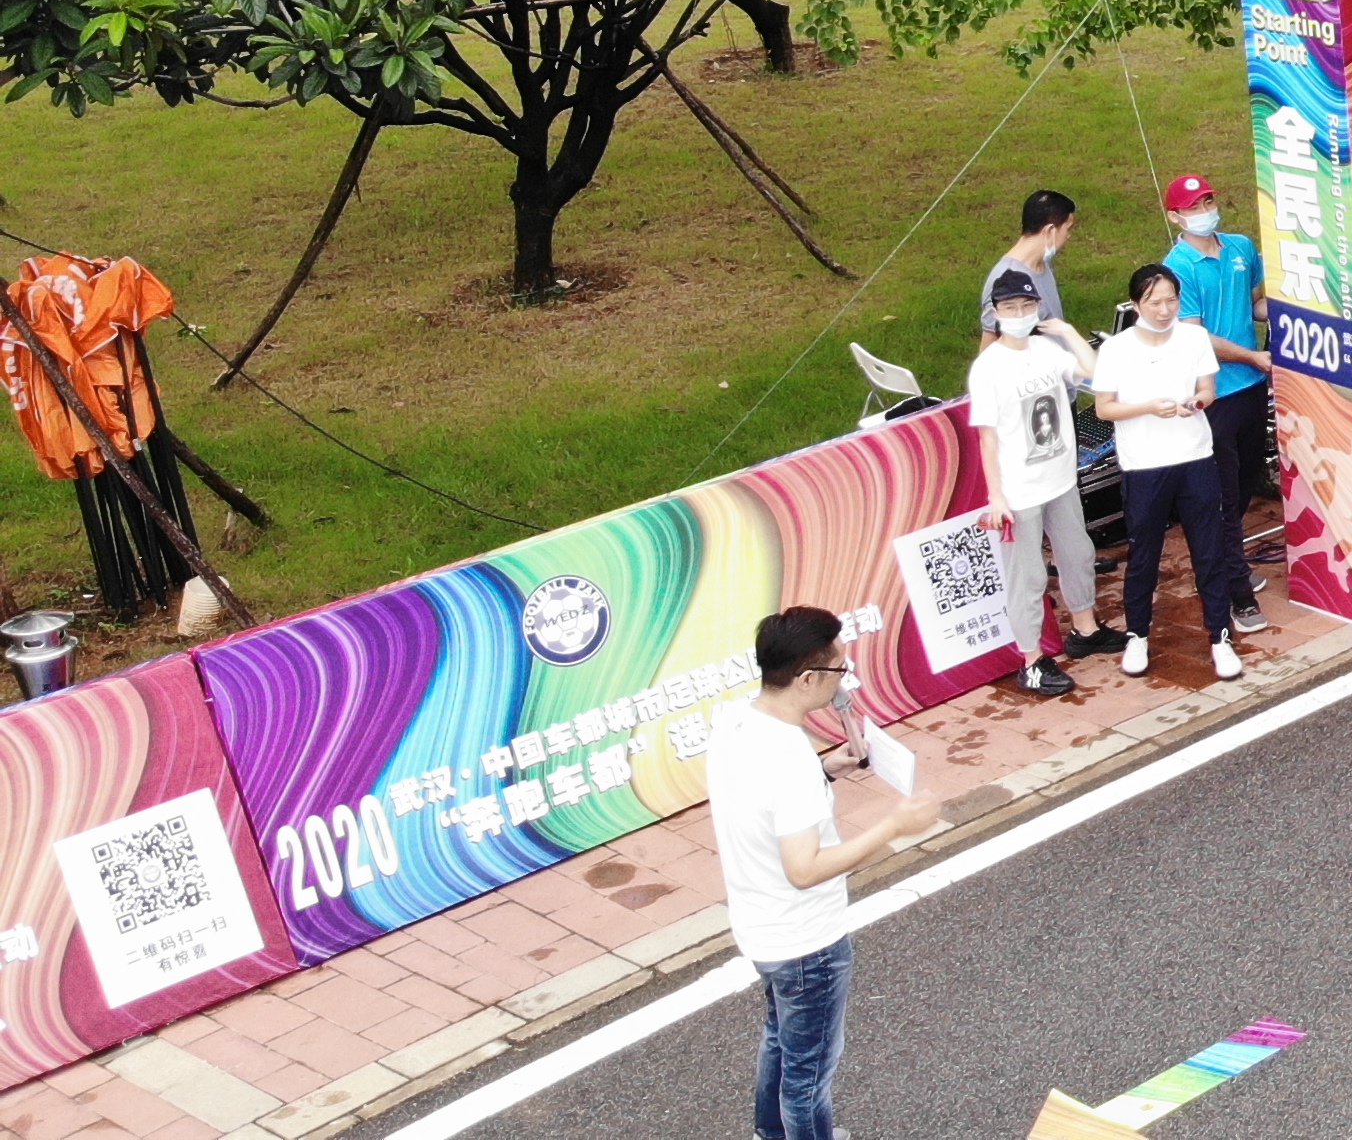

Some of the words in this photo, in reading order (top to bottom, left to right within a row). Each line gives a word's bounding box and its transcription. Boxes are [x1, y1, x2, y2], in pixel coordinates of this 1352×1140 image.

[1251, 3, 1336, 46] Starting
[1253, 32, 1309, 67] Point
[1327, 113, 1343, 198] Running
[1336, 202, 1347, 232] for
[1336, 231, 1348, 266] the
[1279, 313, 1340, 373] 2020
[524, 577, 566, 636] FOOTBALL
[576, 578, 607, 611] PARK
[543, 603, 591, 628] WEDZ
[277, 793, 400, 911] 2020
[126, 916, 228, 965] 二维码扫一扫
[156, 942, 208, 974] 有惊喜
